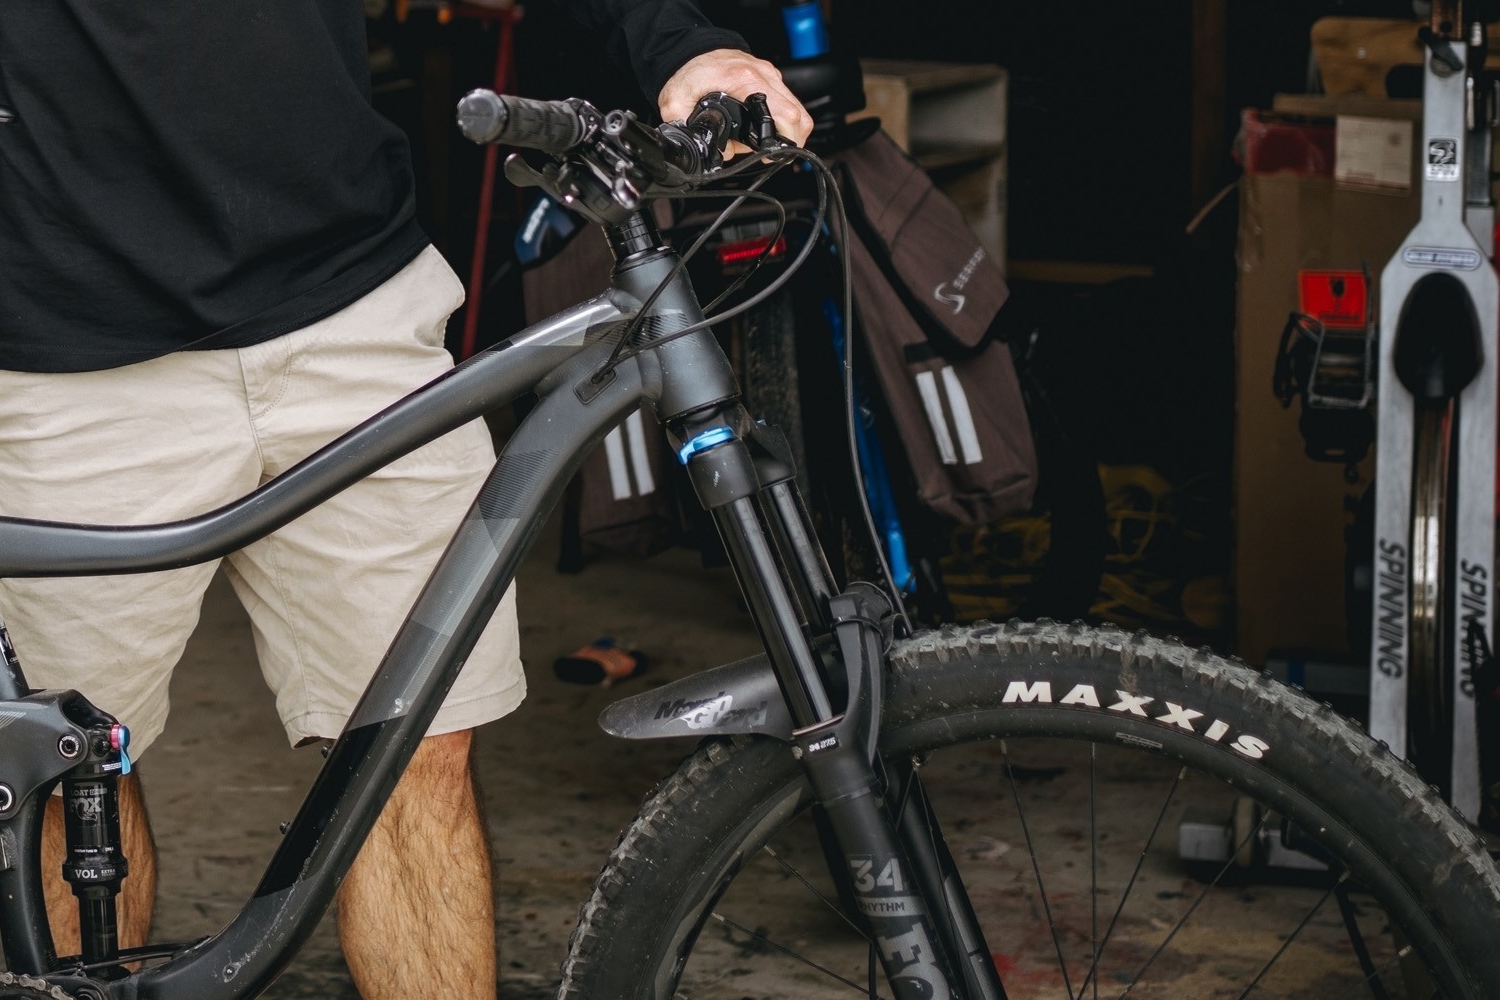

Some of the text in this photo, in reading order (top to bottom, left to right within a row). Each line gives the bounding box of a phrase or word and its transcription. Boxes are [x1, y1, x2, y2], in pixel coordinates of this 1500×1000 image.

[1378, 538, 1405, 680] SPINNING
[1002, 681, 1270, 759] MAXXIS
[74, 868, 99, 879] VOL
[849, 857, 904, 893] 34
